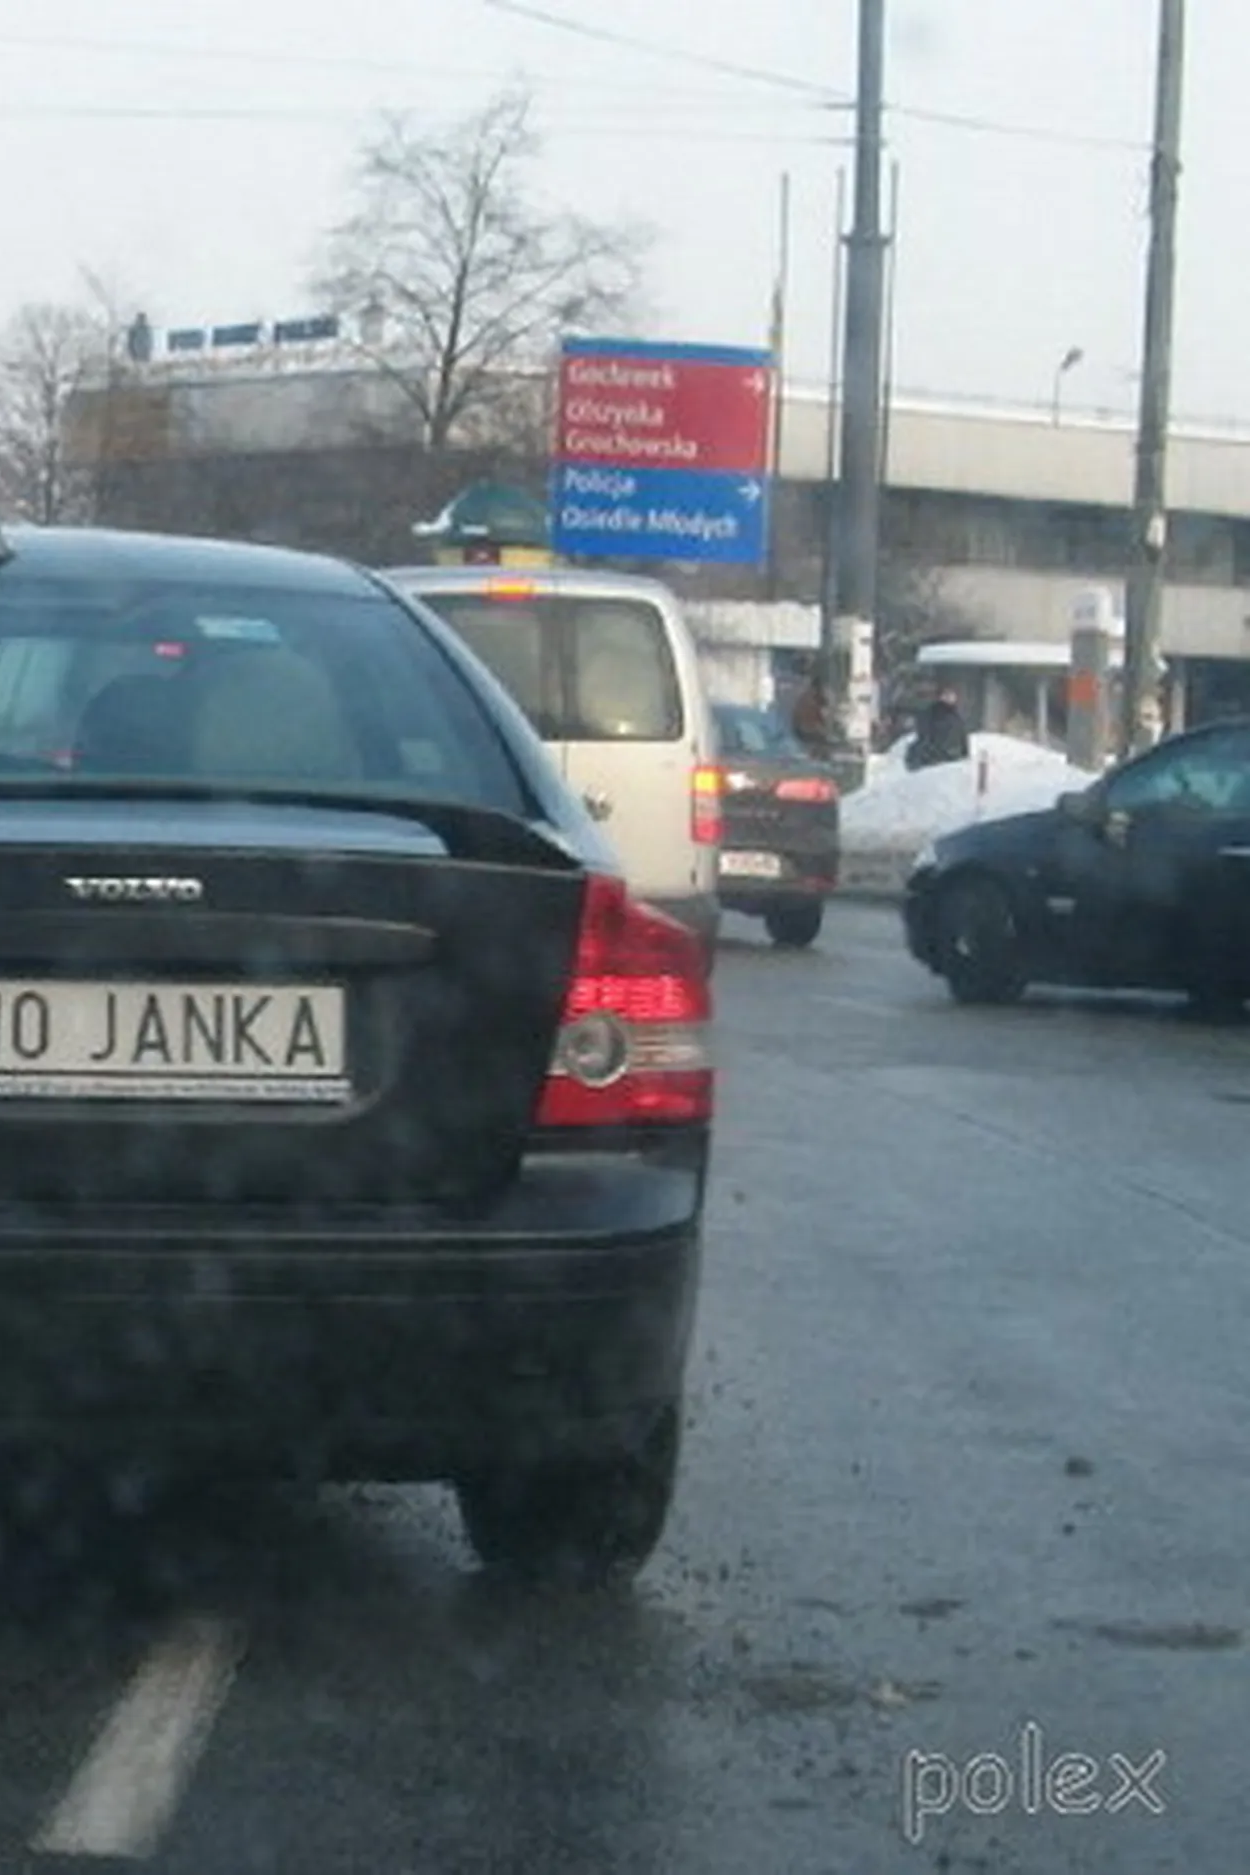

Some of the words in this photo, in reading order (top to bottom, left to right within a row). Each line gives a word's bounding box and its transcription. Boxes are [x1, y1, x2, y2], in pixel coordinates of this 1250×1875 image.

[564, 467, 636, 501] Policja
[64, 876, 204, 899] VOLVO
[89, 992, 327, 1068] JANKA
